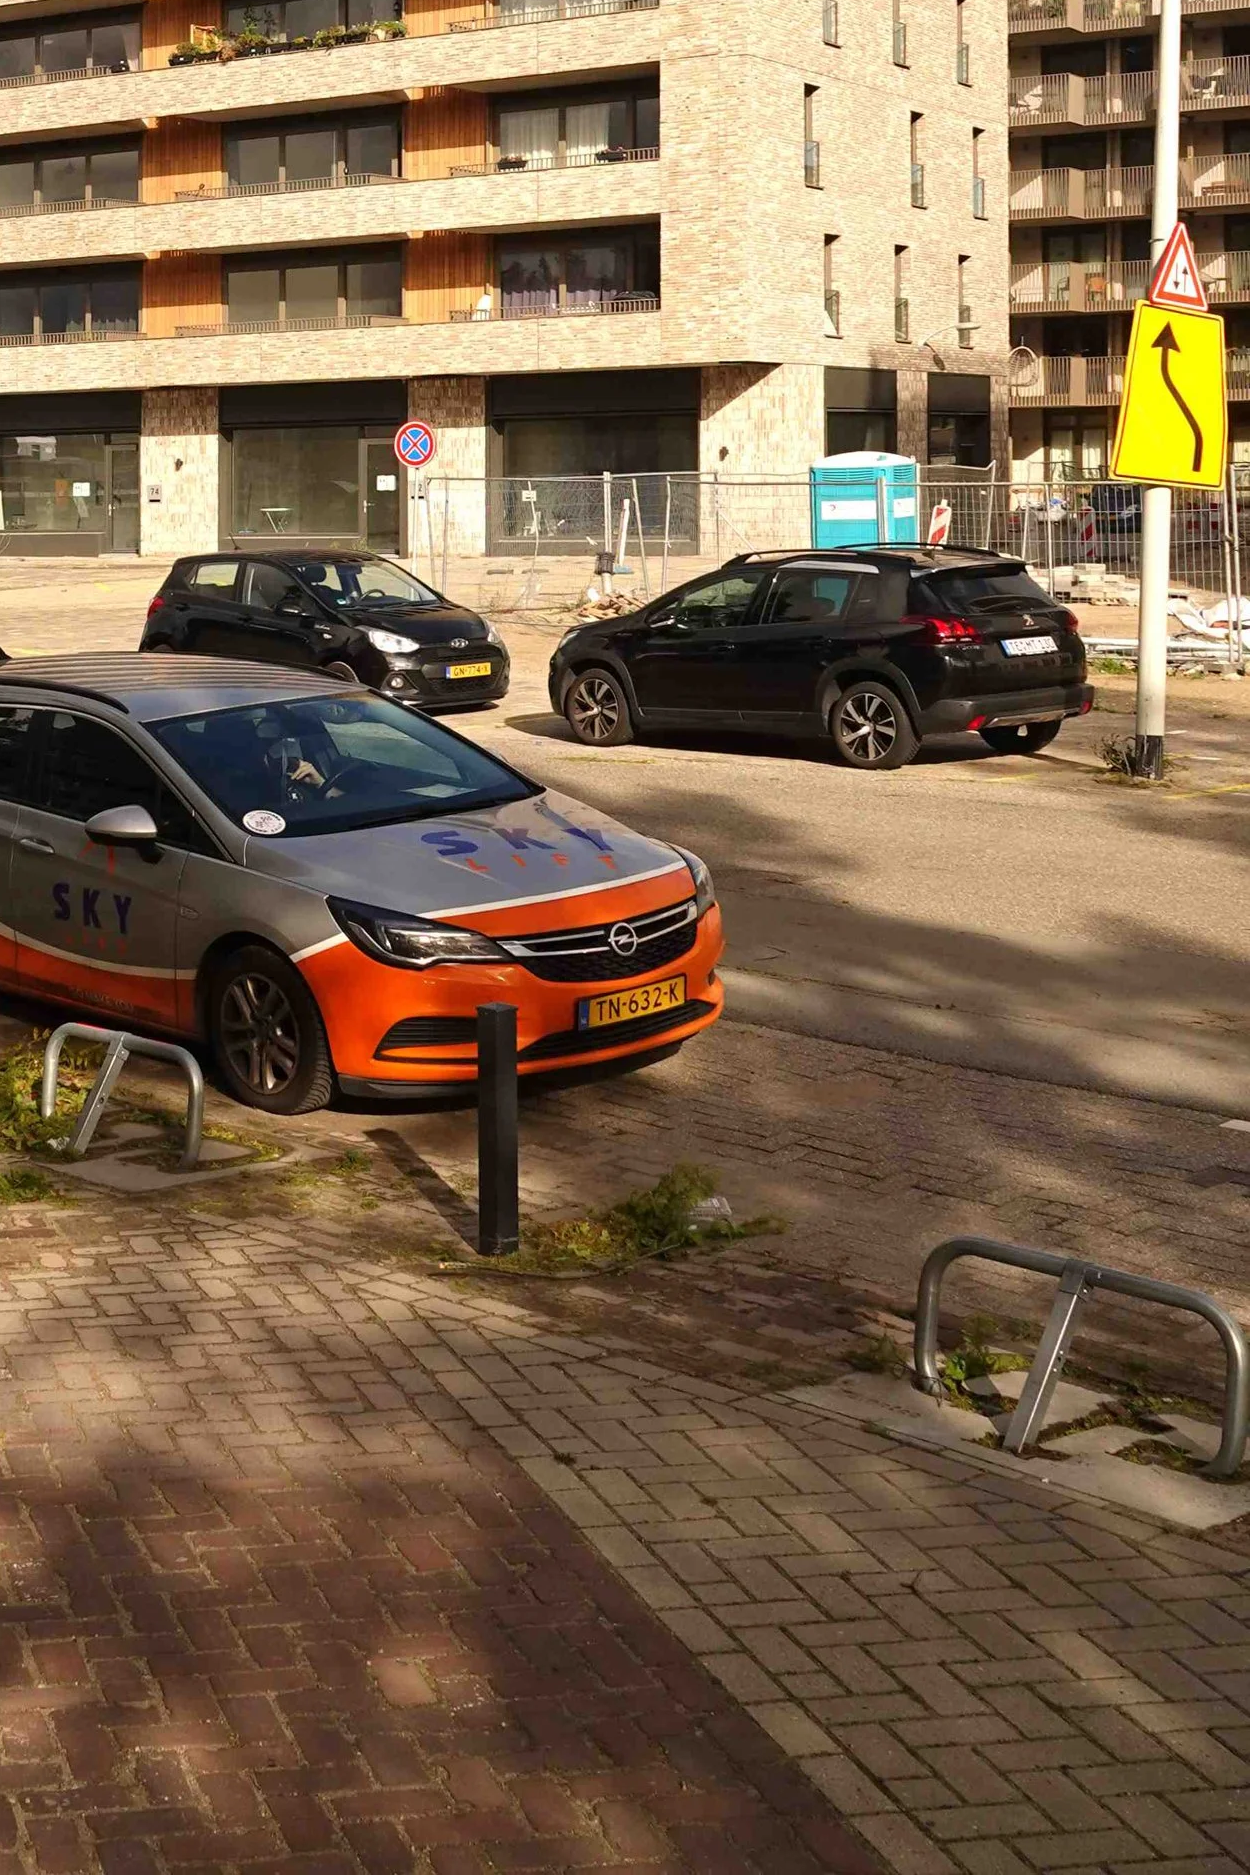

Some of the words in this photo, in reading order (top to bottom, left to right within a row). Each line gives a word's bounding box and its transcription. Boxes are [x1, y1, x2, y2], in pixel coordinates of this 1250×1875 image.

[150, 488, 159, 496] 74
[421, 828, 614, 856] SKY
[465, 853, 617, 873] LIFT
[52, 882, 132, 934] SKY
[596, 982, 679, 1021] TN-632-K
